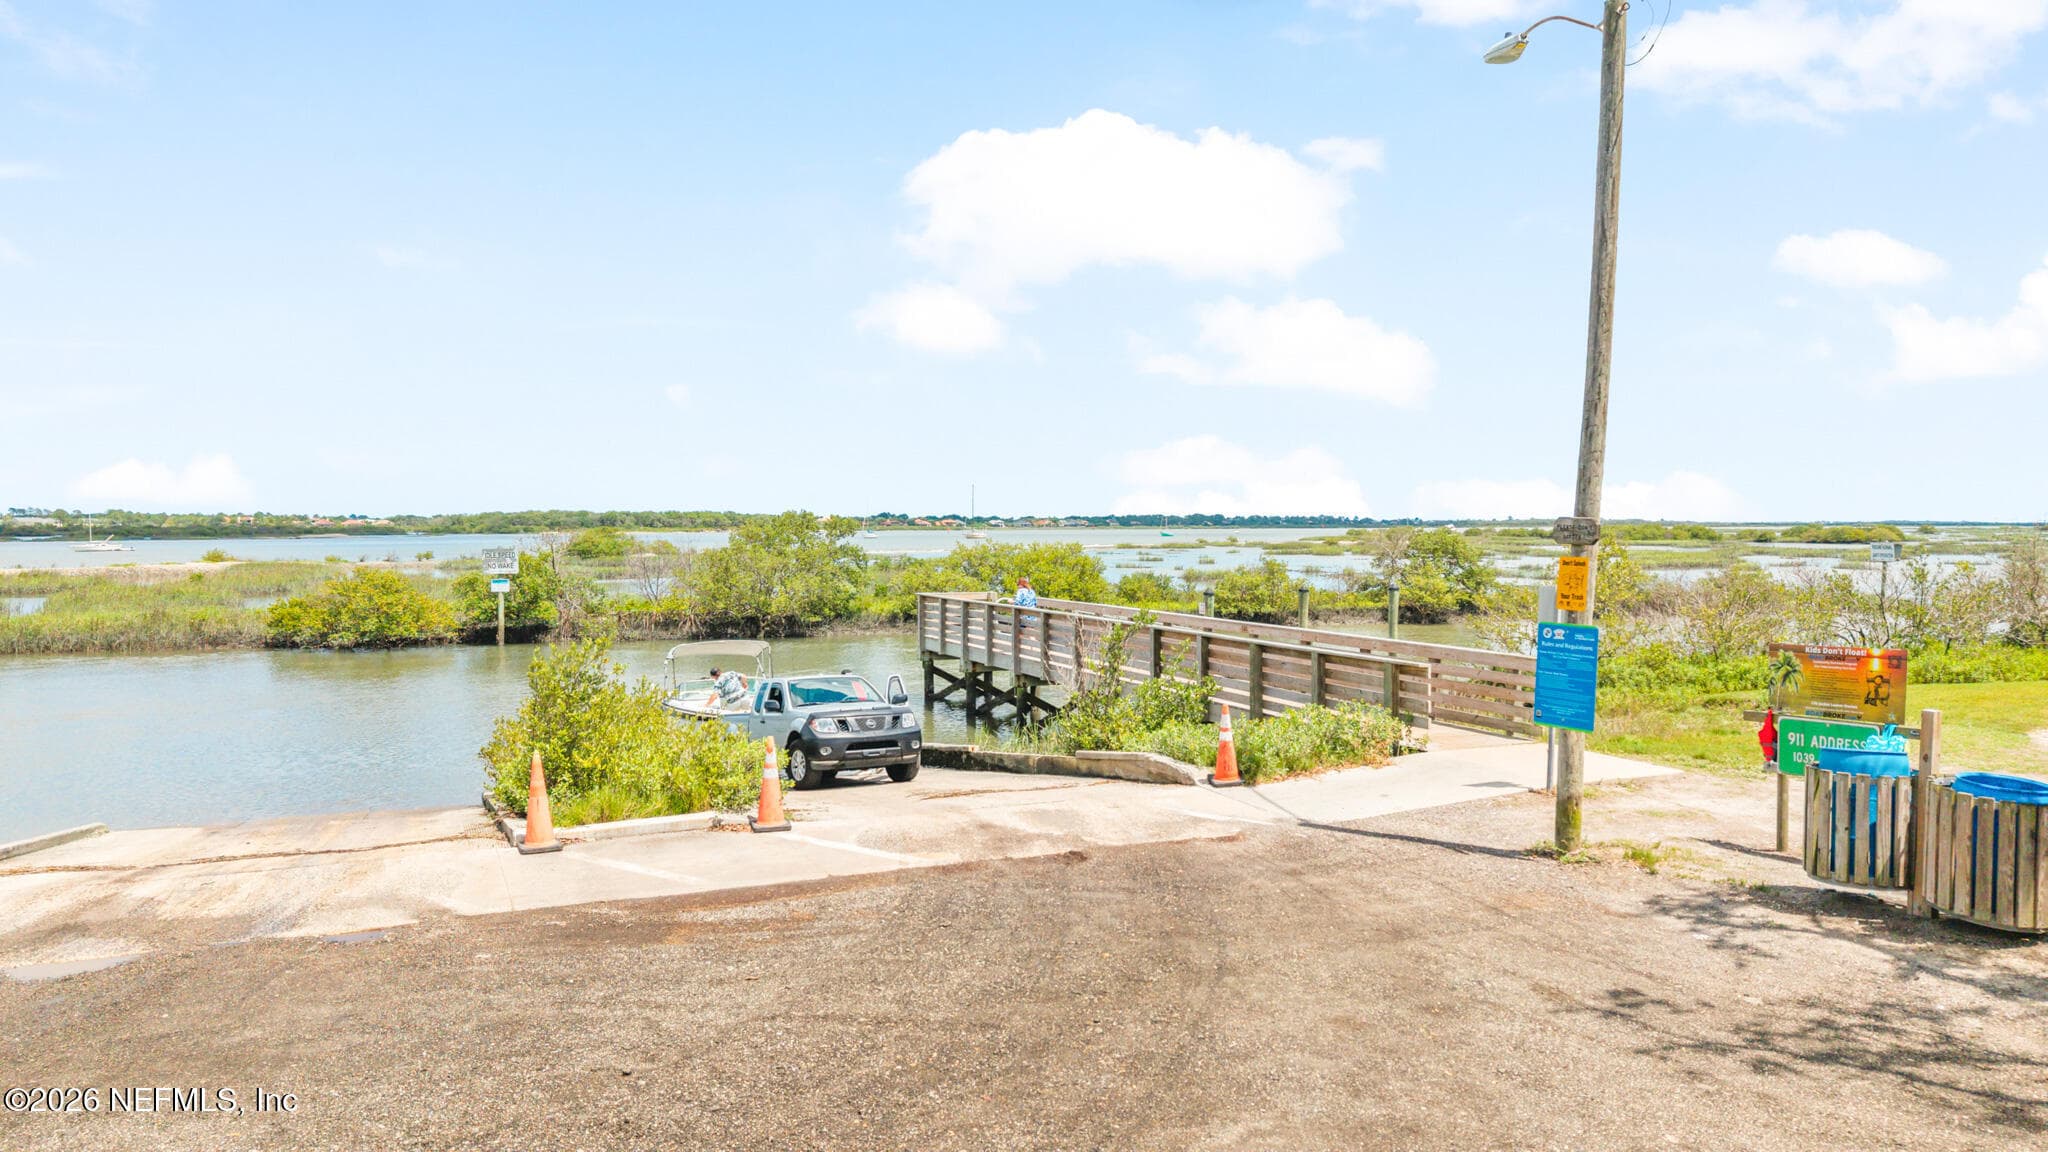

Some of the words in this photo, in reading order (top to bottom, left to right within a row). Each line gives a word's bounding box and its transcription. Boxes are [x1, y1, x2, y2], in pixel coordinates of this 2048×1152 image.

[1805, 646, 1821, 654] Kids
[1822, 647, 1843, 656] Don't
[1844, 648, 1867, 657] Float!
[1788, 732, 1804, 747] 911
[1810, 735, 1867, 751] ADDRESS
[1793, 752, 1815, 764] 1039
